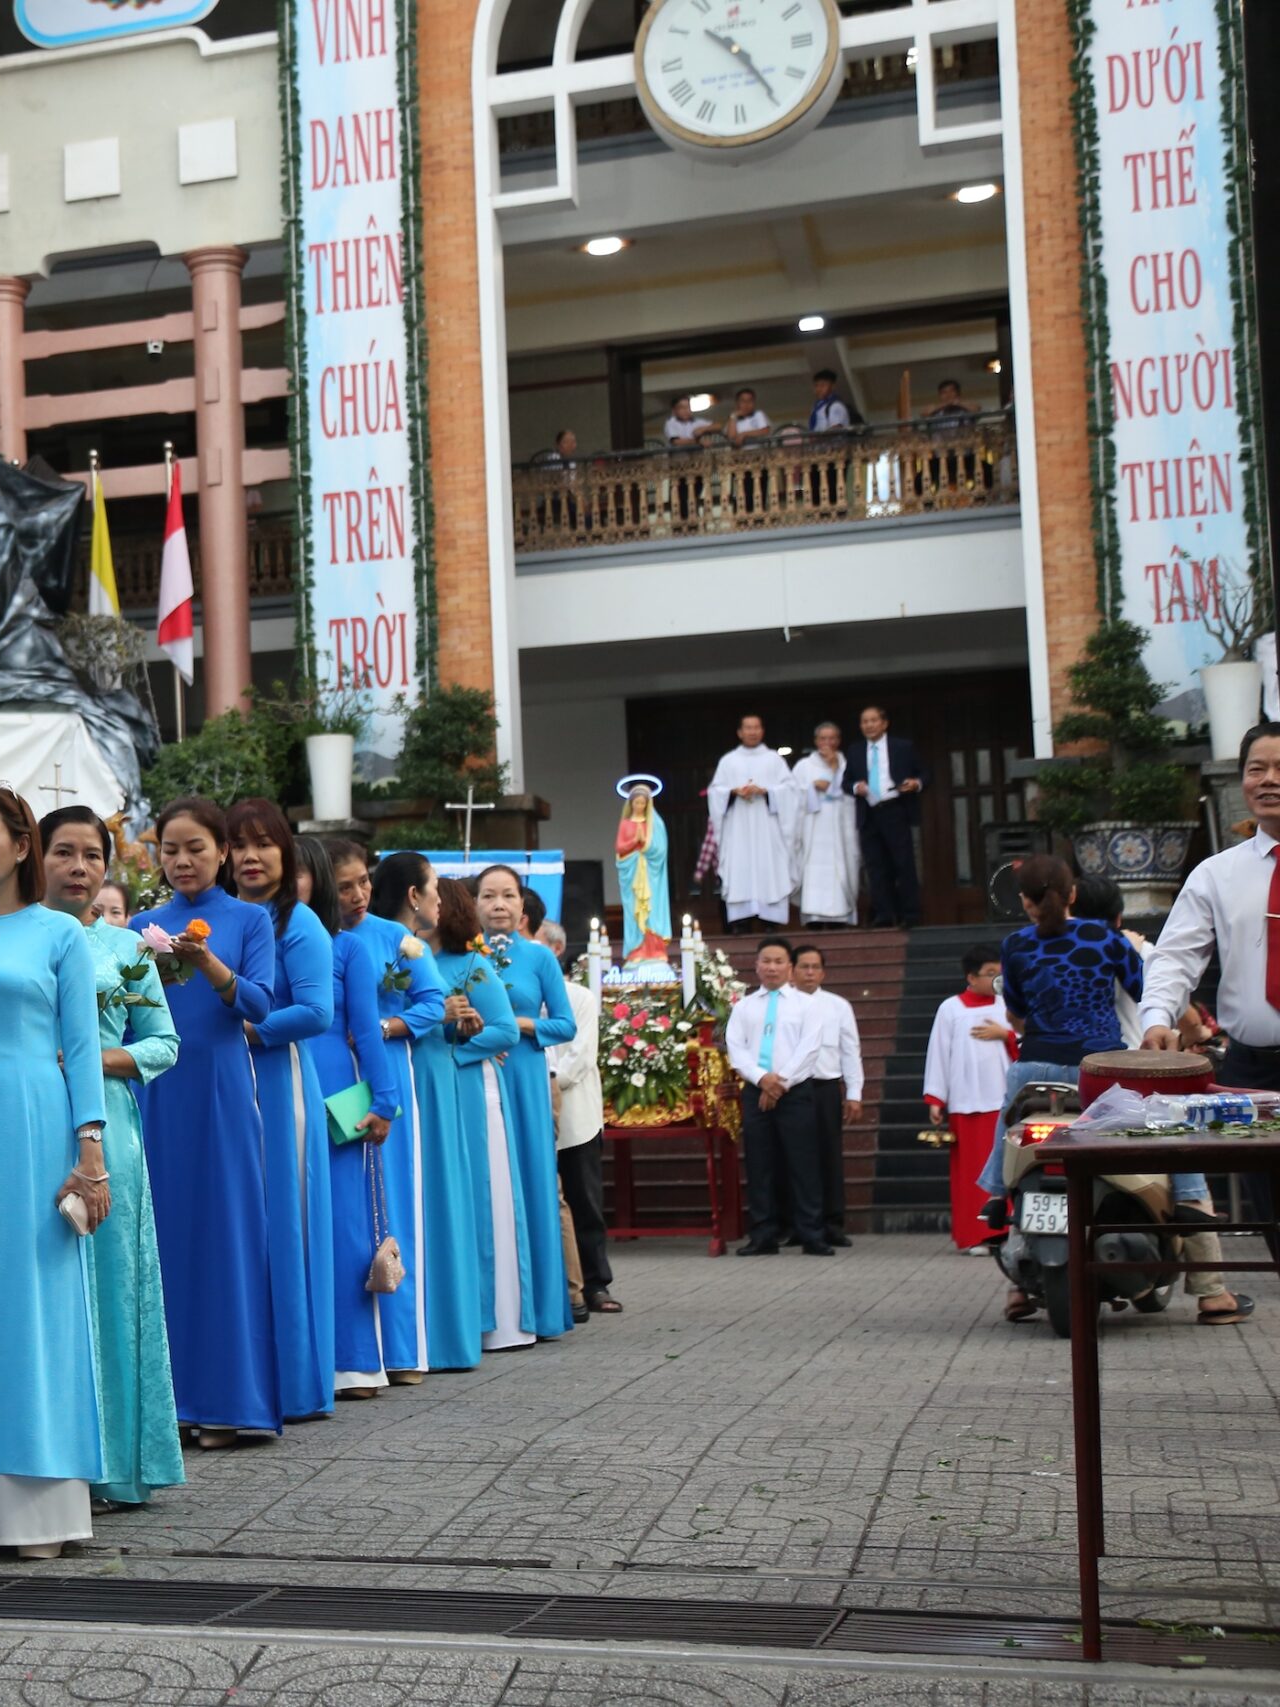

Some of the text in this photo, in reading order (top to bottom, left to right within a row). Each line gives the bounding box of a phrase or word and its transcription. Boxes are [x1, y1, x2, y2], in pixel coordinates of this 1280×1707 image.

[310, 0, 388, 66] VINH
[1106, 26, 1205, 114] DƯỚI
[309, 108, 396, 191] DANH
[1123, 123, 1197, 213] THẾ
[308, 213, 405, 315] THIÊN
[1130, 248, 1203, 316] CHO
[319, 339, 404, 440] CHÚA
[1110, 332, 1233, 421] NGƯỜI
[322, 466, 405, 565] TRÊN
[1121, 437, 1233, 534] THIỆN
[1144, 544, 1223, 625] TÂM
[328, 591, 409, 692] TRỜI
